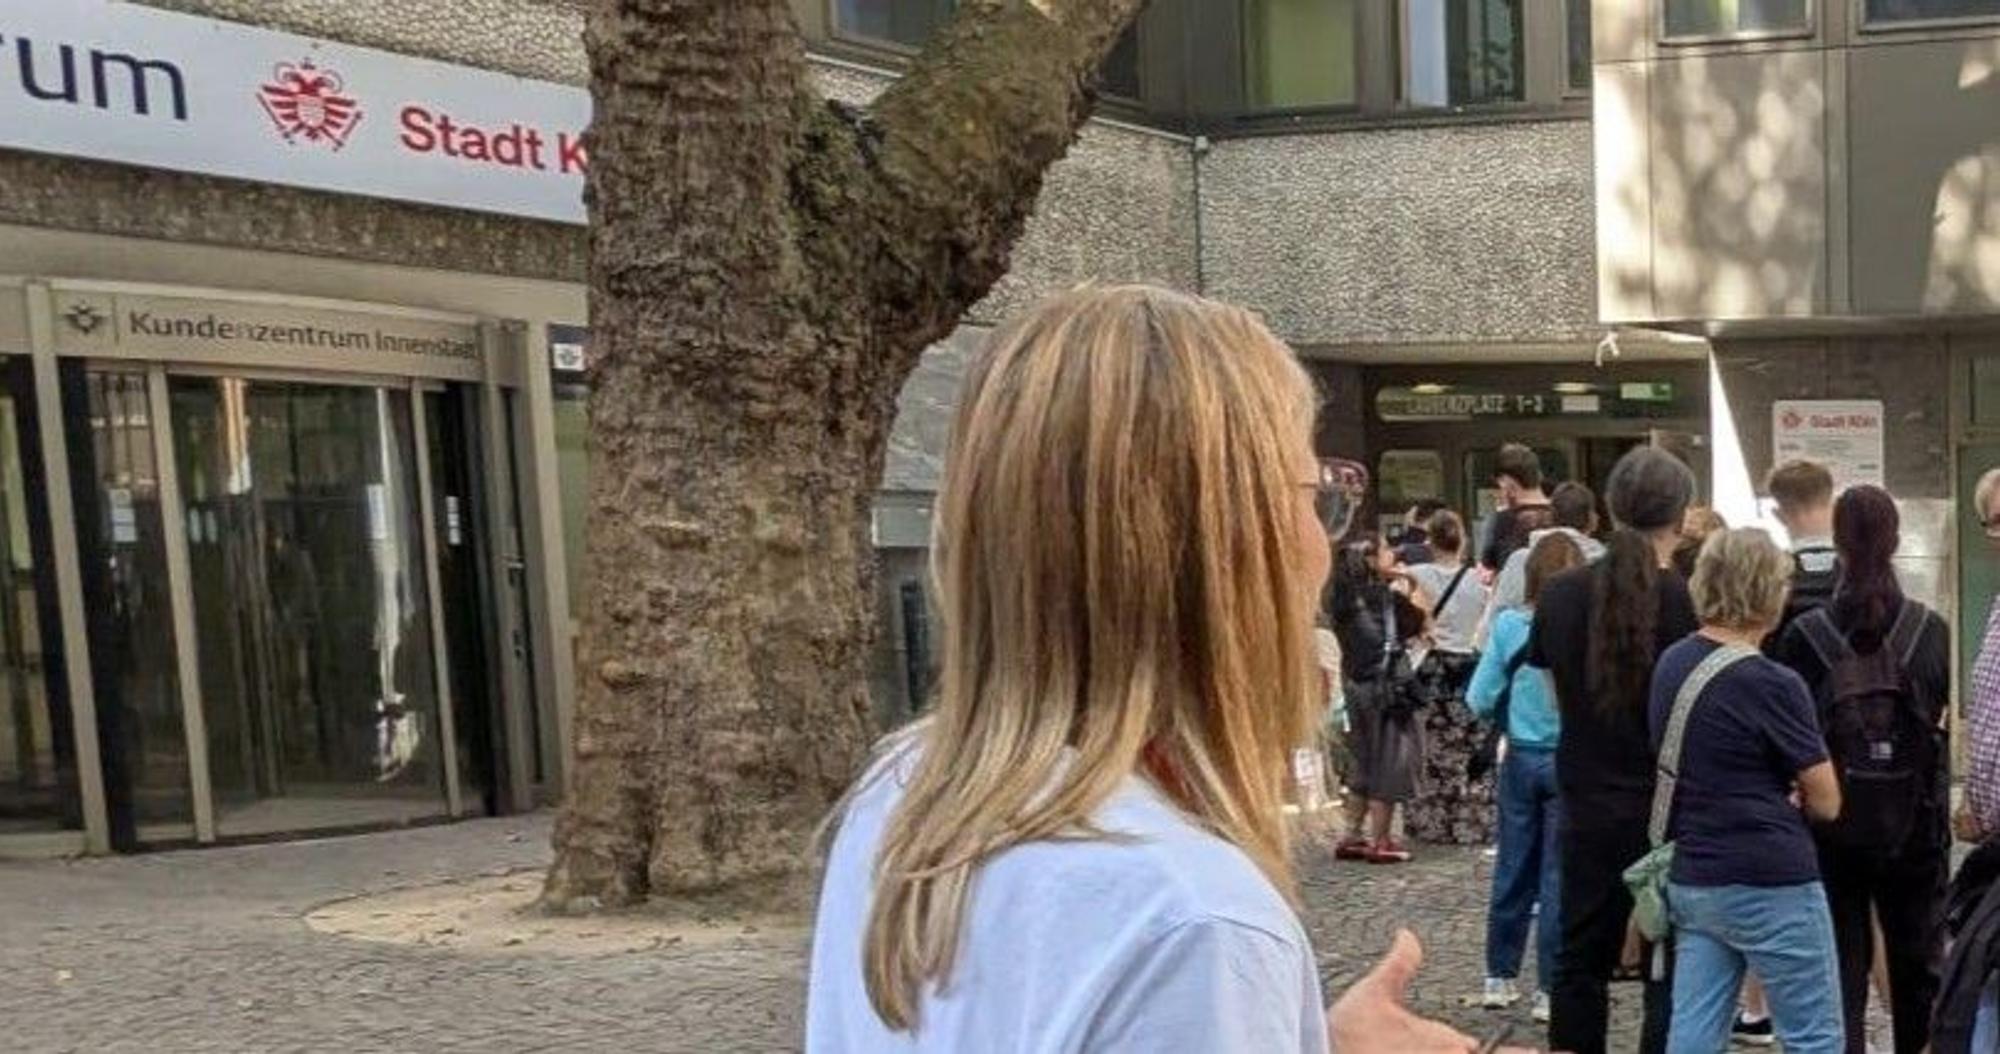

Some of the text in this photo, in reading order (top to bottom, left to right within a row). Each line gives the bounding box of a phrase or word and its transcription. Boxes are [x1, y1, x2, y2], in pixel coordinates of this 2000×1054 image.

[0, 32, 187, 120] um
[400, 106, 546, 171] Stadt
[129, 309, 370, 349] Kundenzentrum
